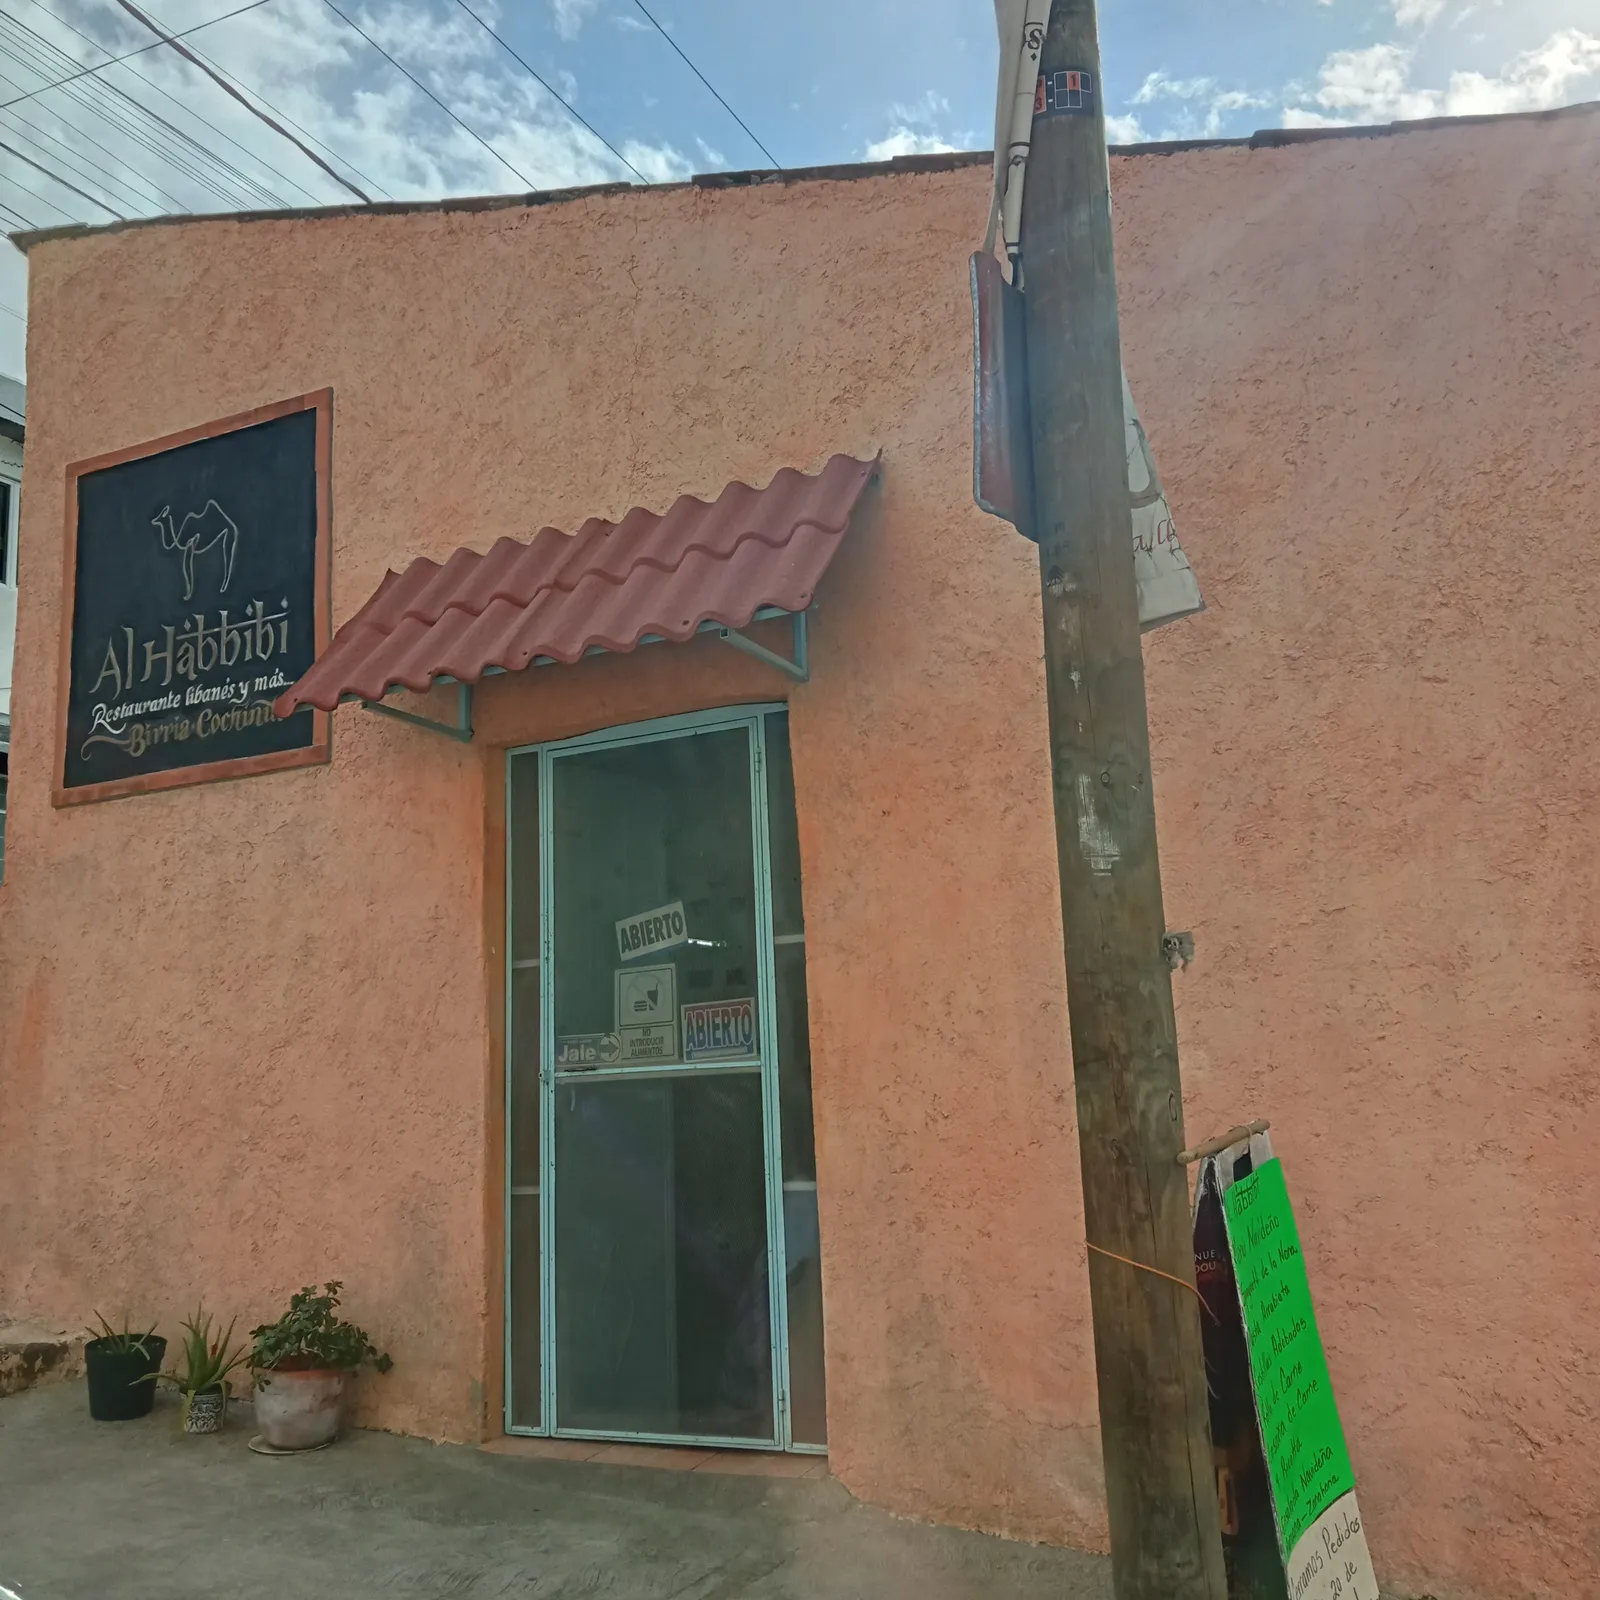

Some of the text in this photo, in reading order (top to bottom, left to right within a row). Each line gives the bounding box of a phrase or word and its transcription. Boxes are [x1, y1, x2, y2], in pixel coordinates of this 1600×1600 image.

[88, 596, 291, 700] Al Habbibi
[88, 690, 181, 734] Restaurante
[185, 677, 236, 706] libanés
[228, 681, 250, 703] y
[118, 716, 190, 758] Birria
[620, 910, 684, 953] ABIERTO
[629, 1036, 664, 1048] INTRODUCIR
[642, 1028, 652, 1037] NO
[684, 1004, 754, 1051] ABIERTO
[558, 1043, 597, 1062] Jale
[630, 1046, 664, 1057] ALIMENTOS
[1261, 1258, 1270, 1279] de
[1267, 1251, 1278, 1271] la
[1280, 1360, 1303, 1394] Carne
[1286, 1402, 1297, 1424] de
[1297, 1378, 1320, 1410] Carne
[1321, 1511, 1360, 1561] Pedidos
[1343, 1561, 1358, 1582] de
